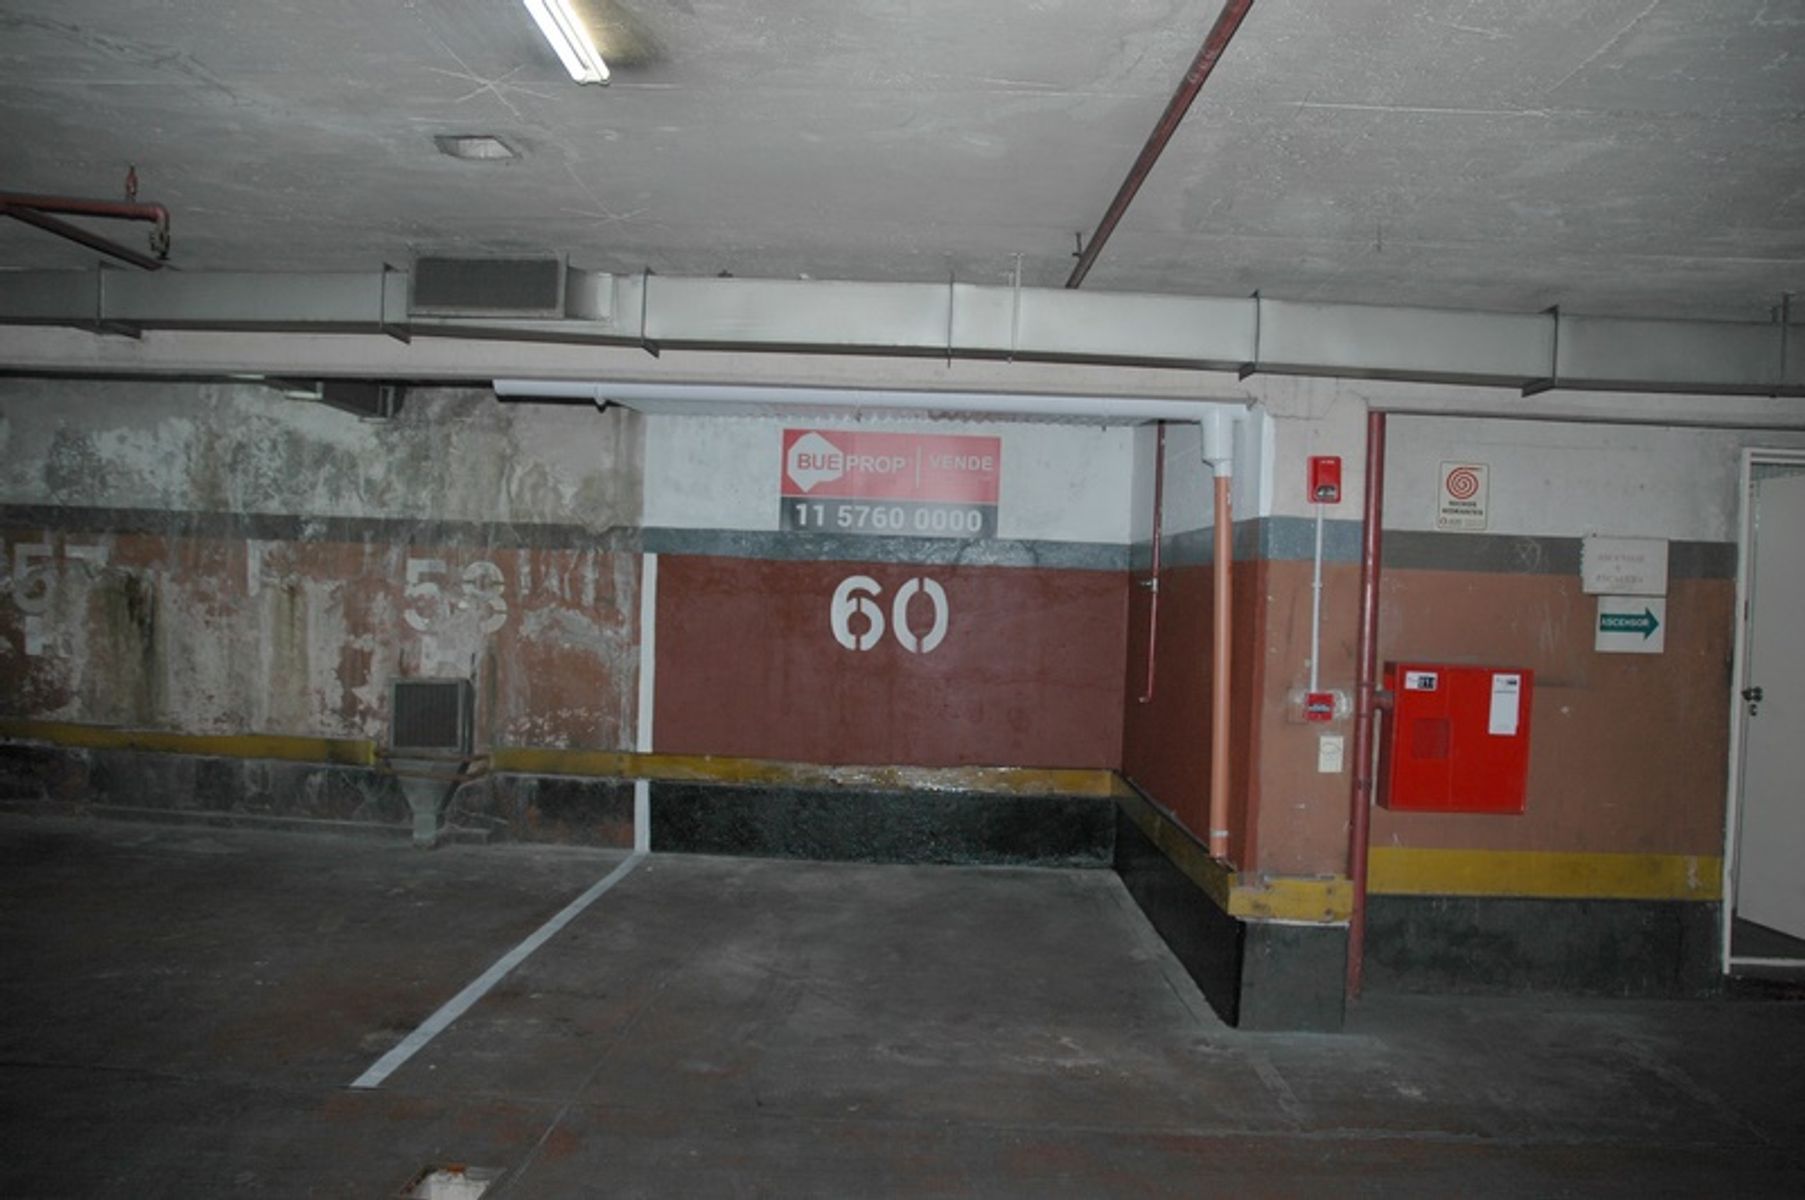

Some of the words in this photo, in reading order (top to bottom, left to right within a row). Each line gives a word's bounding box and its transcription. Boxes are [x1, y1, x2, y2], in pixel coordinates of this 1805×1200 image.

[929, 454, 994, 471] VENDE
[796, 503, 824, 527] 11
[837, 505, 904, 529] 5760
[915, 508, 983, 532] 0000
[830, 574, 949, 654] 60
[1601, 616, 1650, 627] ASCENSOR
